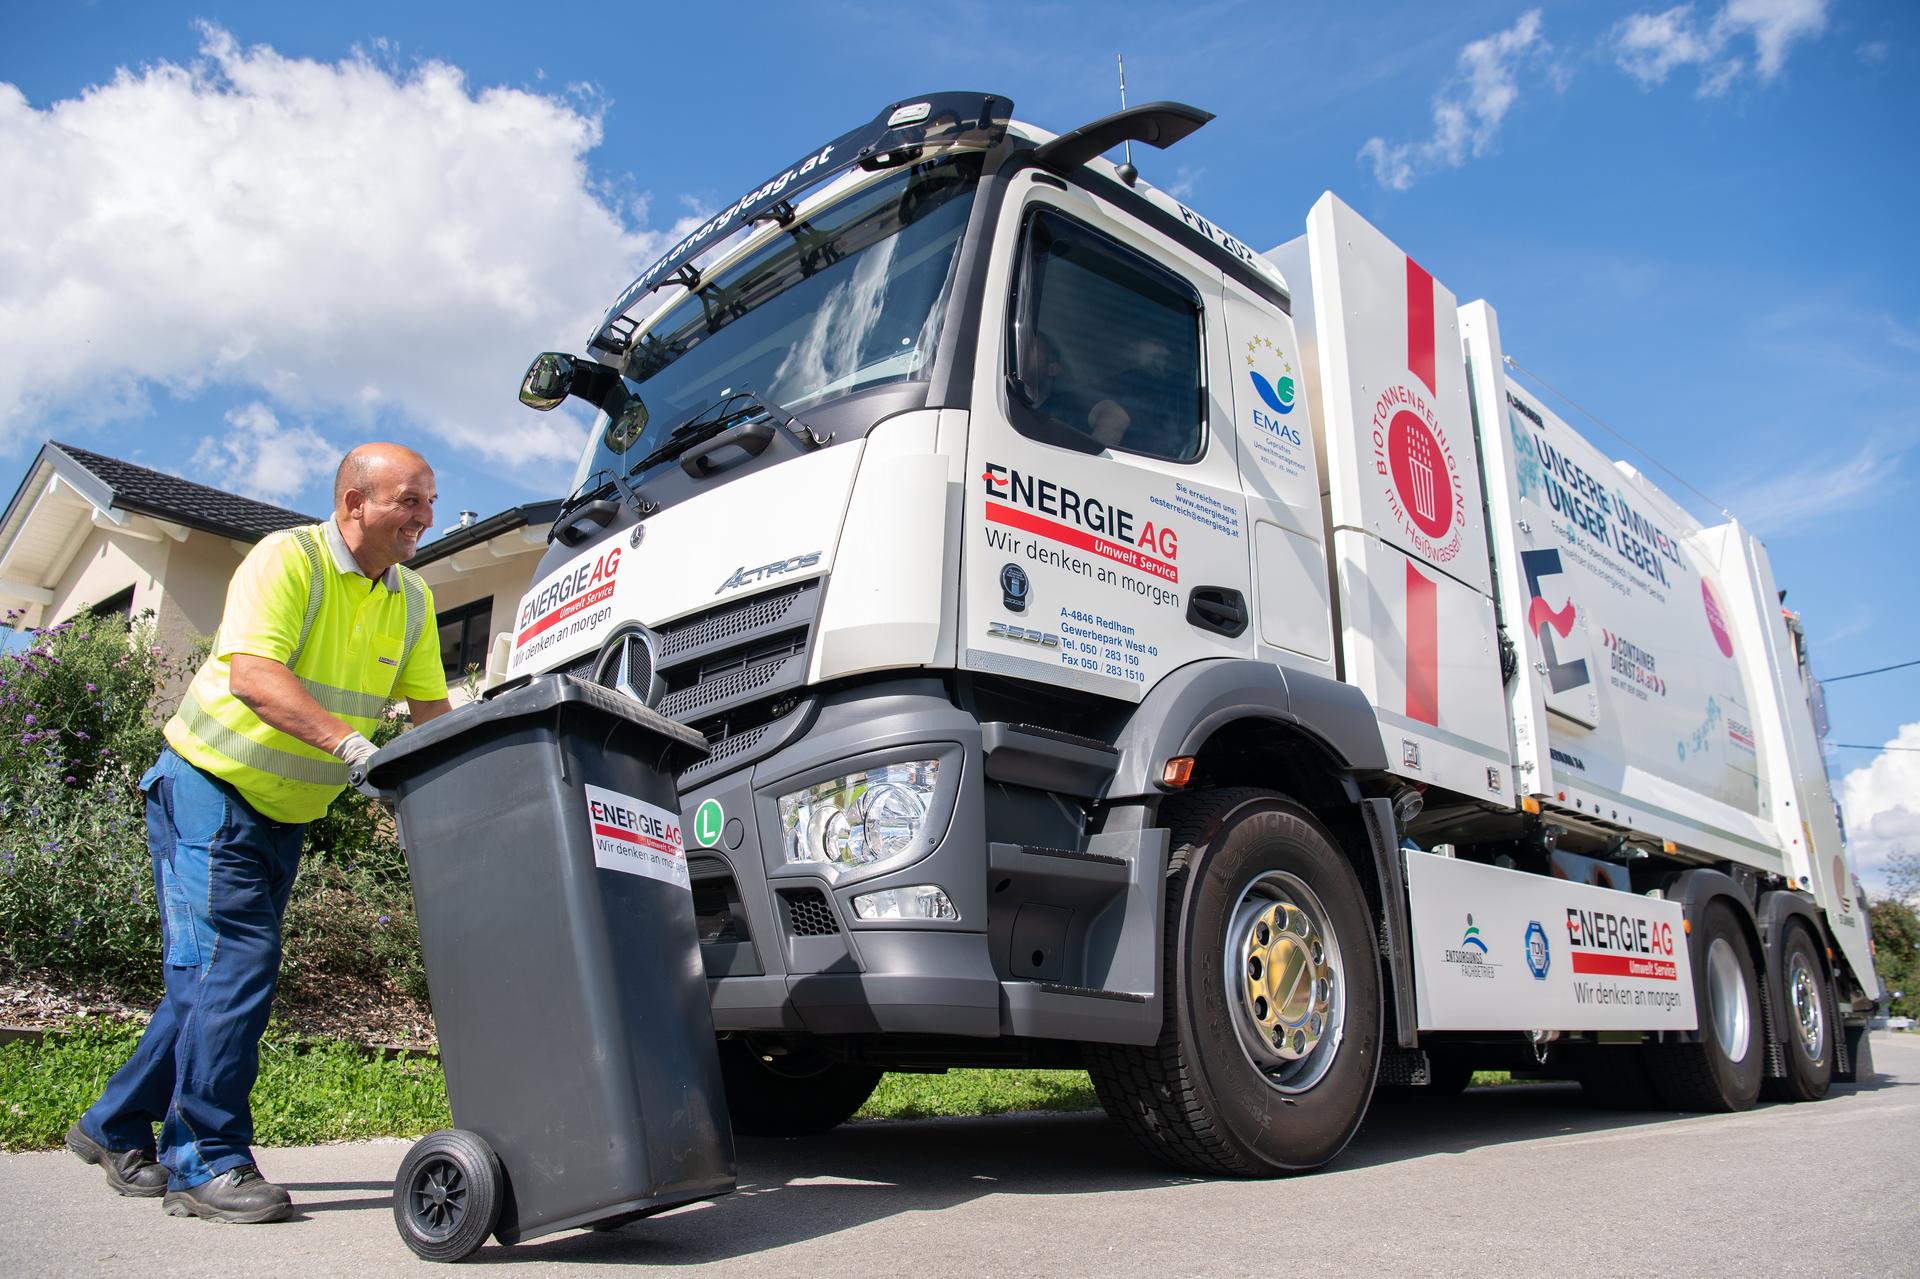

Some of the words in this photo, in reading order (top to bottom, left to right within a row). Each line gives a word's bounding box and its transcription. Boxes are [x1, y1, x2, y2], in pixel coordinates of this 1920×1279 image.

[1177, 204, 1214, 241] PW
[1253, 409, 1301, 447] EMAS
[1373, 385, 1465, 527] BIOTONNENREINIGUNG
[1534, 433, 1612, 515] UNSERE
[1175, 494, 1239, 527] www.energieag.at
[1176, 482, 1188, 493] Sie
[1189, 487, 1222, 509] erreichen
[1385, 488, 1403, 524] mit
[1150, 495, 1239, 538] oesterreich@energieag.at
[1543, 474, 1611, 547] UNSER
[1612, 523, 1671, 589] LEBEN.
[985, 526, 1021, 550] Wir
[1027, 541, 1092, 578] denken
[1097, 567, 1116, 586] an
[1122, 575, 1179, 608] morgen
[1095, 539, 1137, 565] Umwelt
[1140, 556, 1176, 580] Service
[559, 597, 585, 619] Umwelt
[586, 585, 613, 606] Service
[512, 649, 525, 670] Wir
[525, 633, 556, 659] denken
[557, 628, 569, 640] an
[570, 605, 612, 636] morgen
[1060, 607, 1093, 625] A-4846
[1096, 617, 1135, 636] Redlham
[1061, 622, 1122, 649] Gewerbepark
[1126, 636, 1146, 653] West
[1147, 644, 1158, 657] 40
[1062, 637, 1077, 651] Tel.
[1080, 642, 1097, 656] 050
[1105, 648, 1122, 661] 283
[1124, 652, 1139, 666] 150
[1061, 652, 1079, 668] Fax
[1081, 657, 1098, 671] 050
[1106, 664, 1122, 677] 283
[1125, 668, 1145, 682] 1510
[703, 809, 716, 839] L
[596, 838, 614, 851] Wir
[616, 843, 649, 862] denken
[650, 854, 661, 864] an
[1629, 960, 1653, 975] Umwelt
[1653, 964, 1676, 978] Service
[1574, 982, 1594, 1004] Wir
[1596, 983, 1633, 1006] denken
[1635, 991, 1646, 1006] an
[1647, 991, 1681, 1011] morgen
